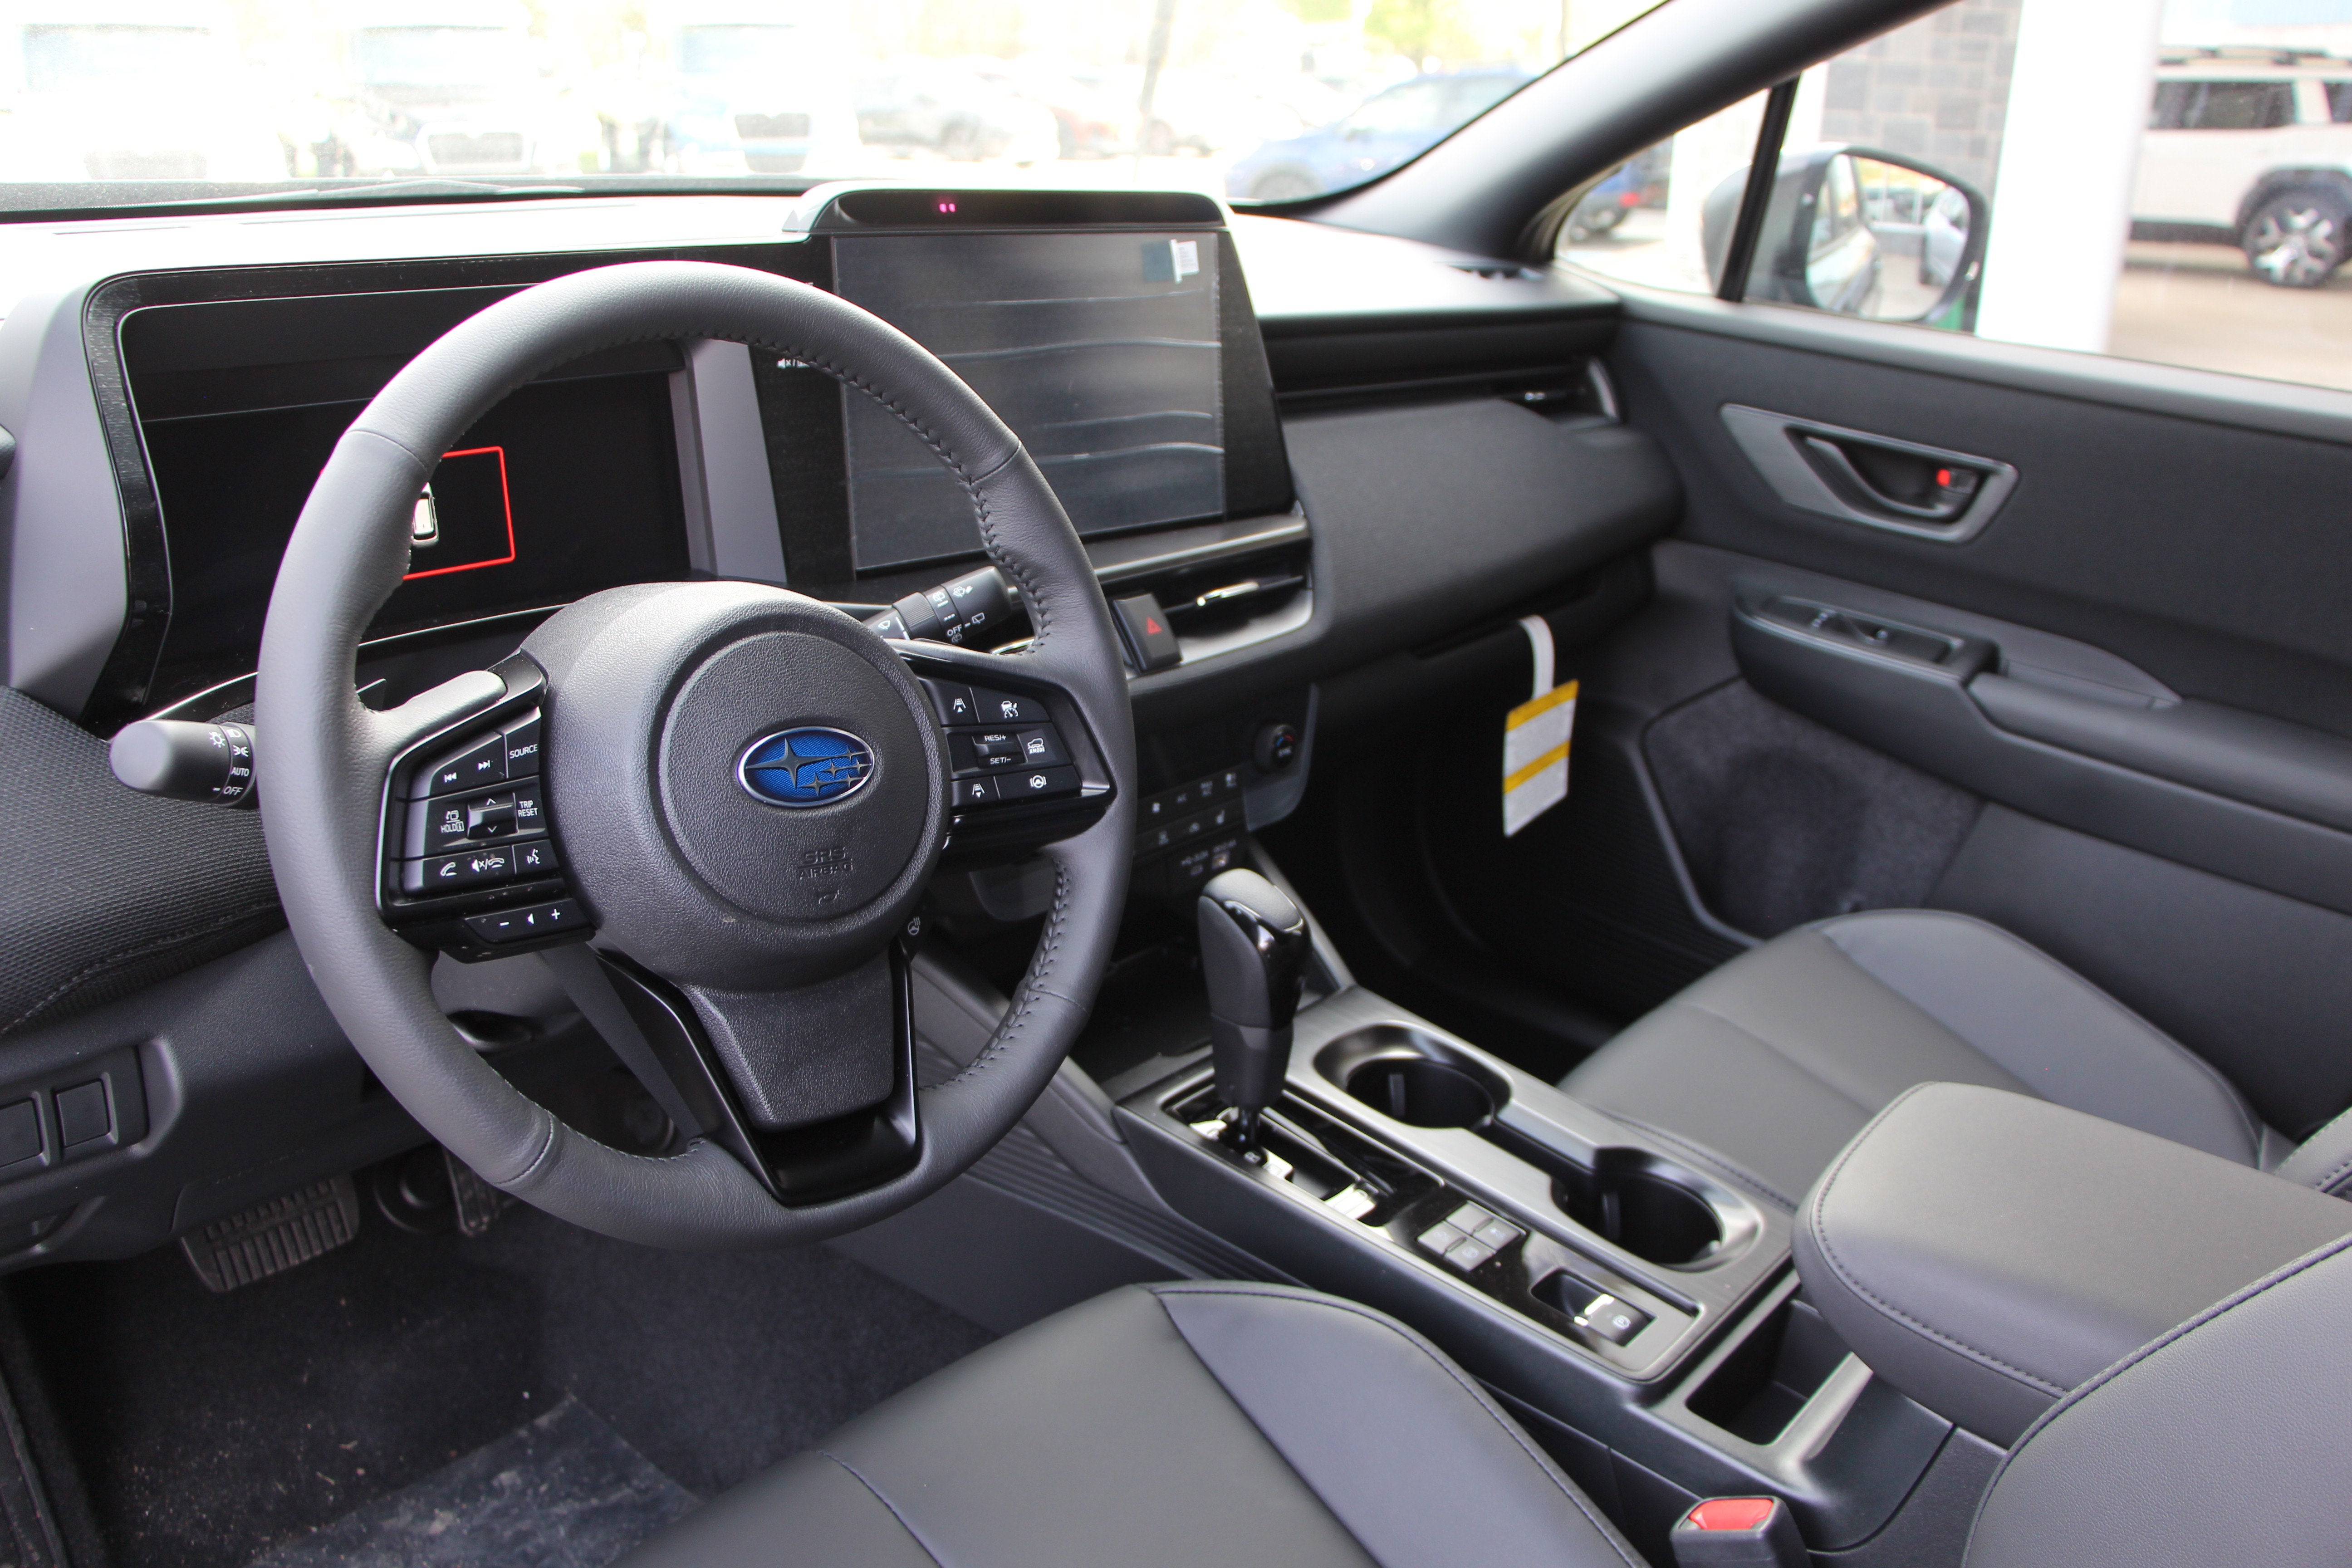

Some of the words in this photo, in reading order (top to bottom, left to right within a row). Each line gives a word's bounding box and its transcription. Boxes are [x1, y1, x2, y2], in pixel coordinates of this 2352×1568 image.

[947, 624, 962, 636] OFF
[510, 744, 538, 759] SOURCE
[231, 767, 250, 777] AUTO
[223, 786, 243, 796] OFF
[519, 800, 534, 808] TRIP
[517, 808, 538, 817] RESET
[804, 847, 846, 865] SRS
[799, 861, 853, 879] AIRBAG
